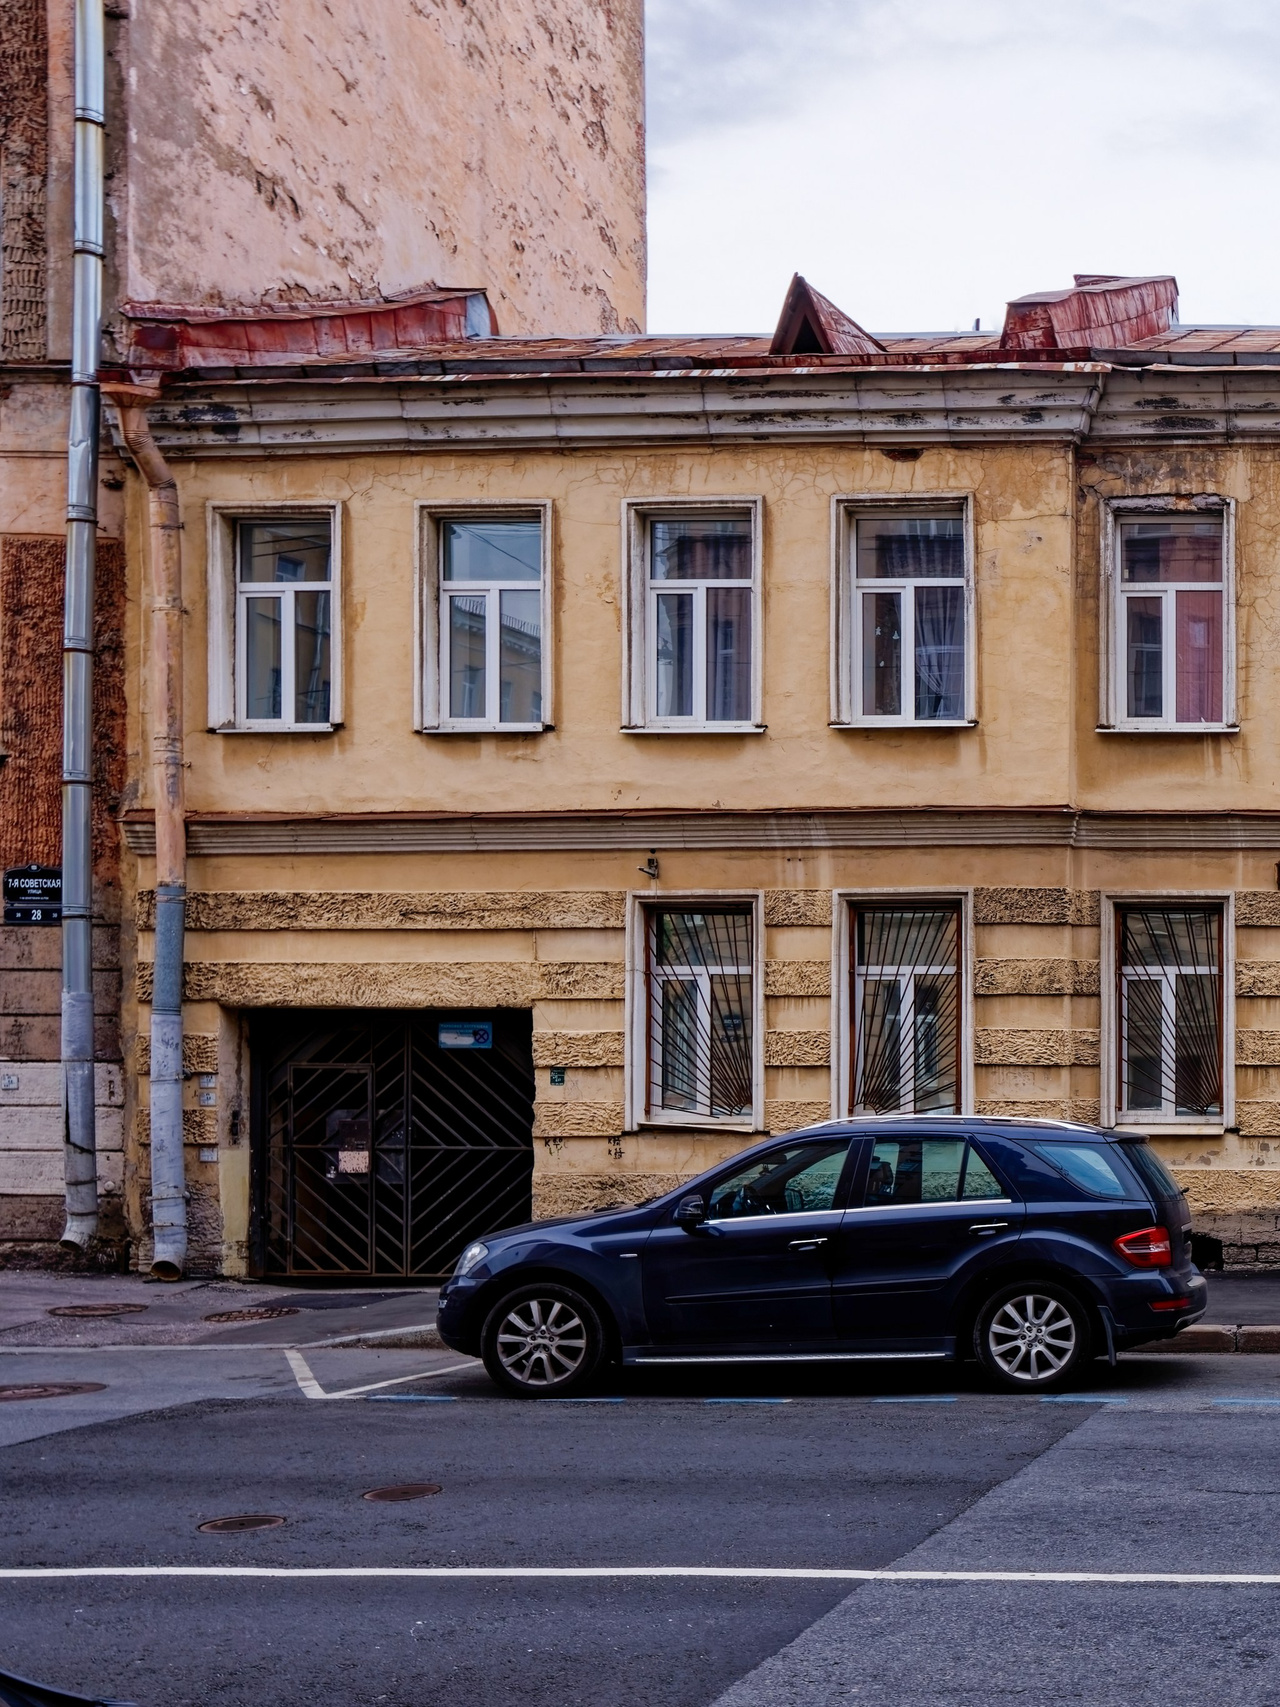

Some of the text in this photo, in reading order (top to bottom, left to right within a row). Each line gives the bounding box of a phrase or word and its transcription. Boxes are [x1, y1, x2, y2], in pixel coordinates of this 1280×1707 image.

[8, 878, 61, 888] 7-Я СОВЕТСКАЯ
[31, 909, 42, 921] 28
